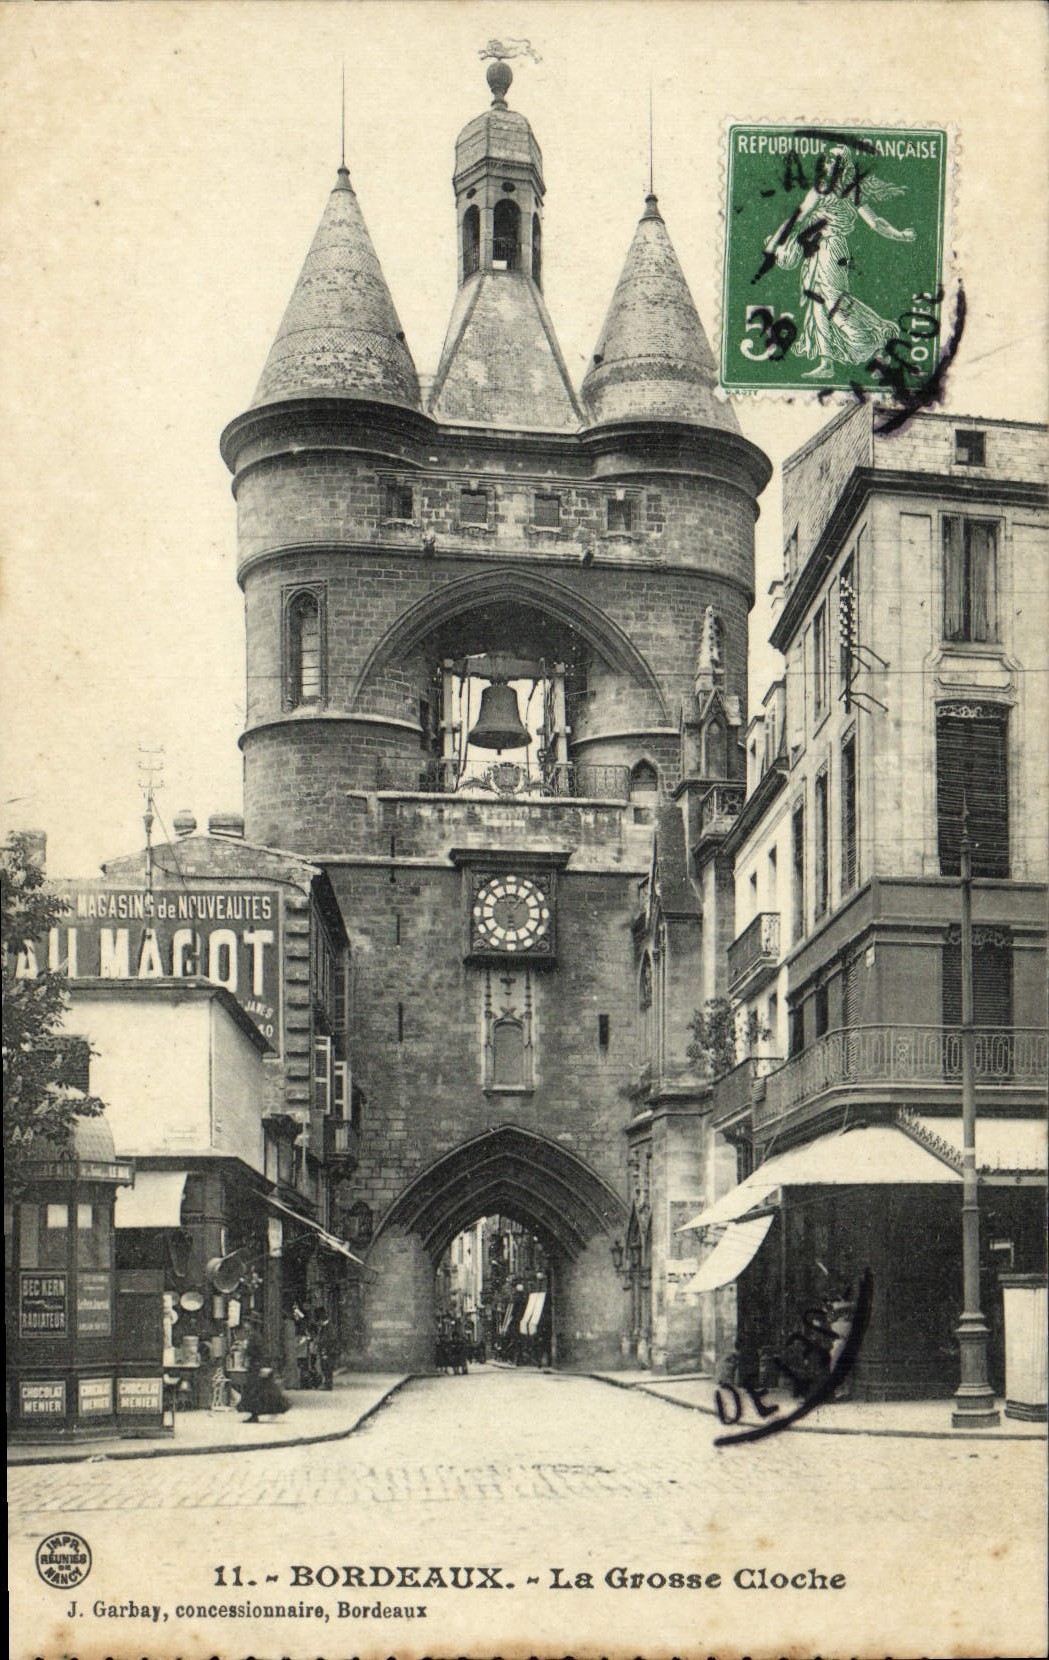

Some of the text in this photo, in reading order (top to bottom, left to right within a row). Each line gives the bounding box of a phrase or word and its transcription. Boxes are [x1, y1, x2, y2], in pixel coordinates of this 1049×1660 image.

[77, 894, 155, 918] MAGASINS
[158, 897, 176, 919] de
[178, 895, 272, 920] NOUVEAUTES
[100, 927, 274, 996] MAGOT
[23, 1400, 62, 1412] MENIER
